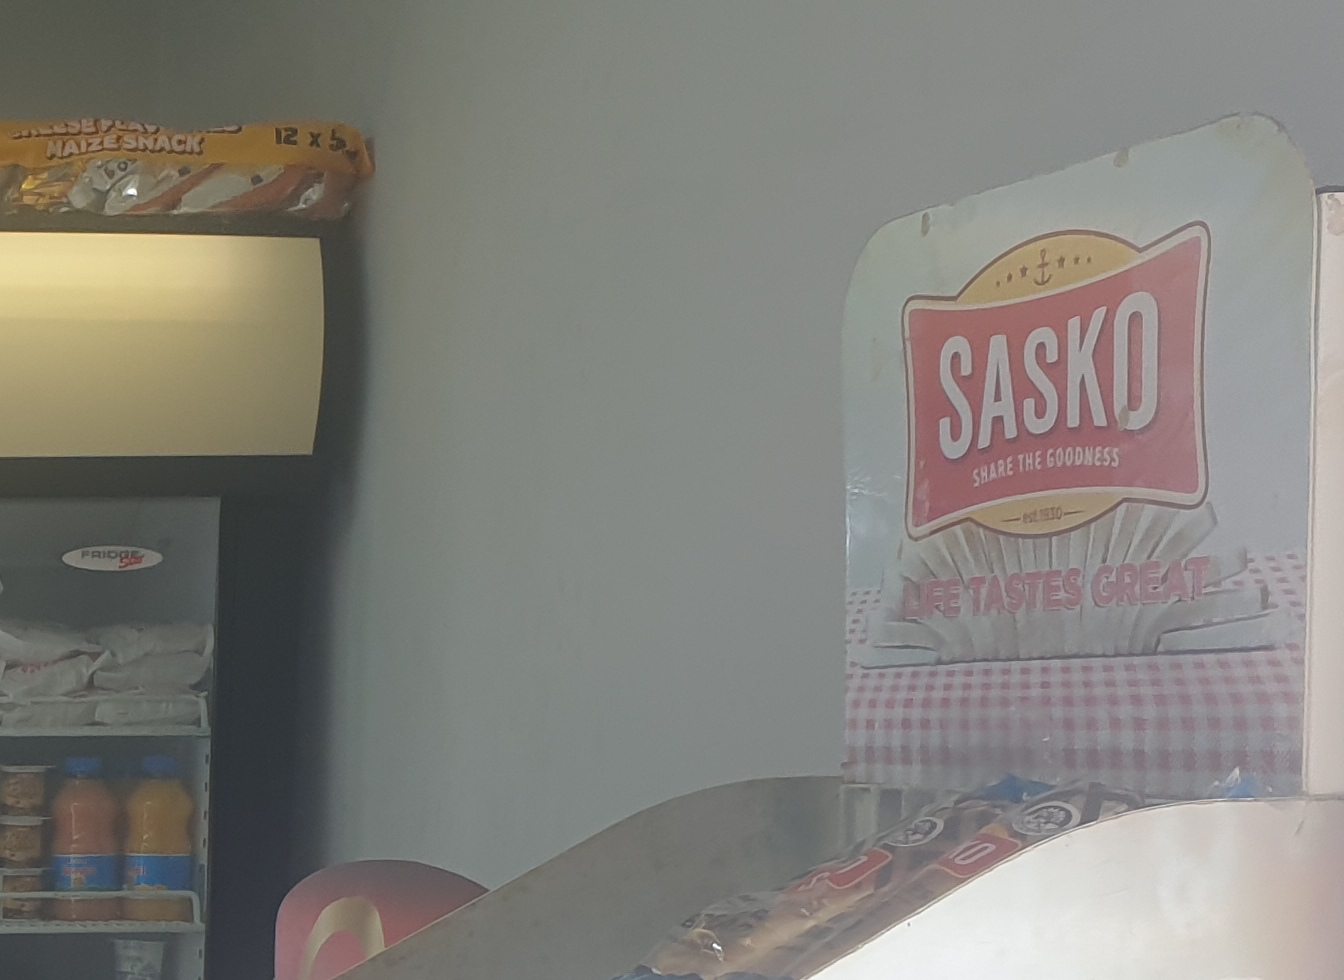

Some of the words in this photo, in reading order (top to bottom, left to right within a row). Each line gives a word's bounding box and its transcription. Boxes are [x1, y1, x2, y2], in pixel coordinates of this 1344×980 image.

[122, 133, 205, 156] SNACK
[274, 126, 299, 145] 12
[937, 291, 1160, 461] SASKO
[972, 455, 1013, 488] SHARE
[1018, 450, 1042, 474] THE
[1046, 447, 1120, 470] GOODNESS
[81, 549, 138, 560] FRIDGE
[903, 578, 961, 620] LIFE
[966, 567, 1086, 617] TASTES
[1091, 555, 1210, 608] GREAT
